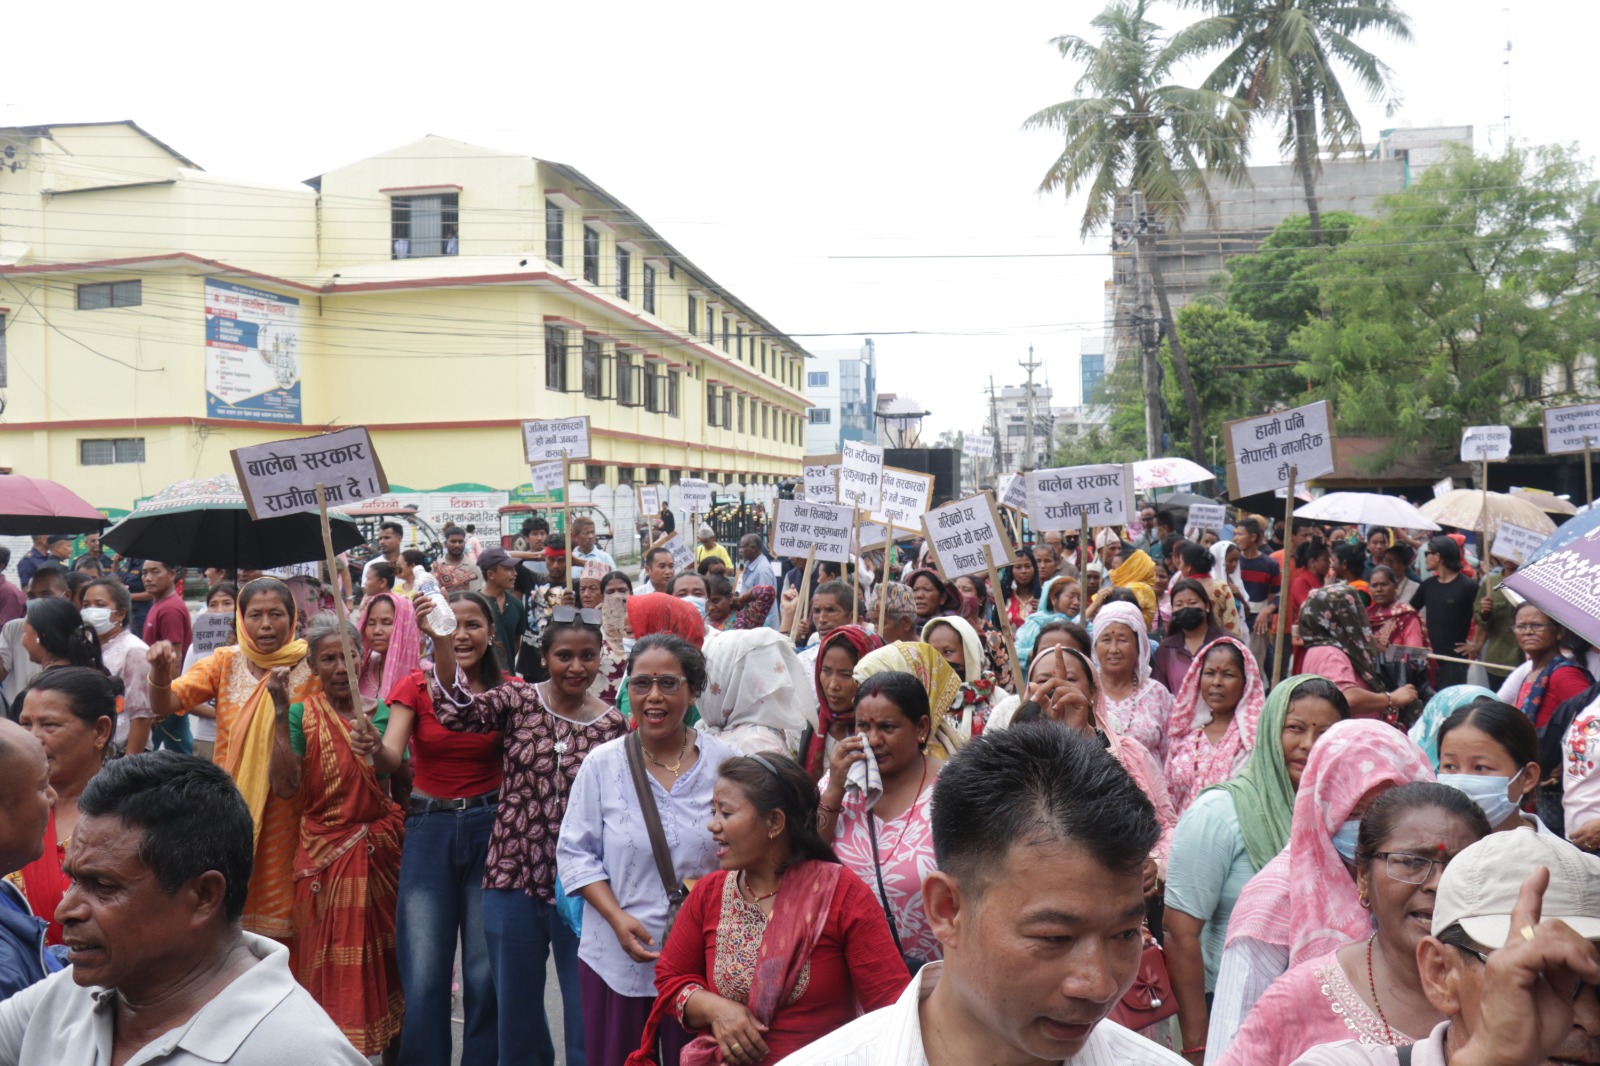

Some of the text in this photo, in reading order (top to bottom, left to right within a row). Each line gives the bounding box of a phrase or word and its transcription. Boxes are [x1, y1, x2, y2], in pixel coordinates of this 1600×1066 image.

[528, 419, 584, 433] जमिन सरकारको
[1254, 412, 1305, 440] हामी पनि
[536, 435, 544, 446] हो
[558, 435, 578, 444] जनता
[1240, 432, 1323, 465] नेपाली नागरिक
[247, 442, 365, 476] बालेन सरकार
[843, 444, 854, 458] देश
[806, 467, 825, 478] देश
[895, 478, 926, 494] सरकारको
[1038, 473, 1120, 492] बालेन सरकार
[263, 486, 342, 511] राजीनमा
[347, 477, 363, 498] दे
[450, 496, 484, 508] टिकाउ
[899, 495, 918, 508] जनता
[794, 505, 808, 518] सेना
[1104, 497, 1113, 514] दे
[937, 507, 976, 529] गरिबको घर
[779, 521, 799, 534] सुरक्षा
[800, 524, 811, 535] गर
[963, 529, 974, 545] यो
[973, 523, 994, 542] कस्तो
[953, 553, 977, 570] विकास
